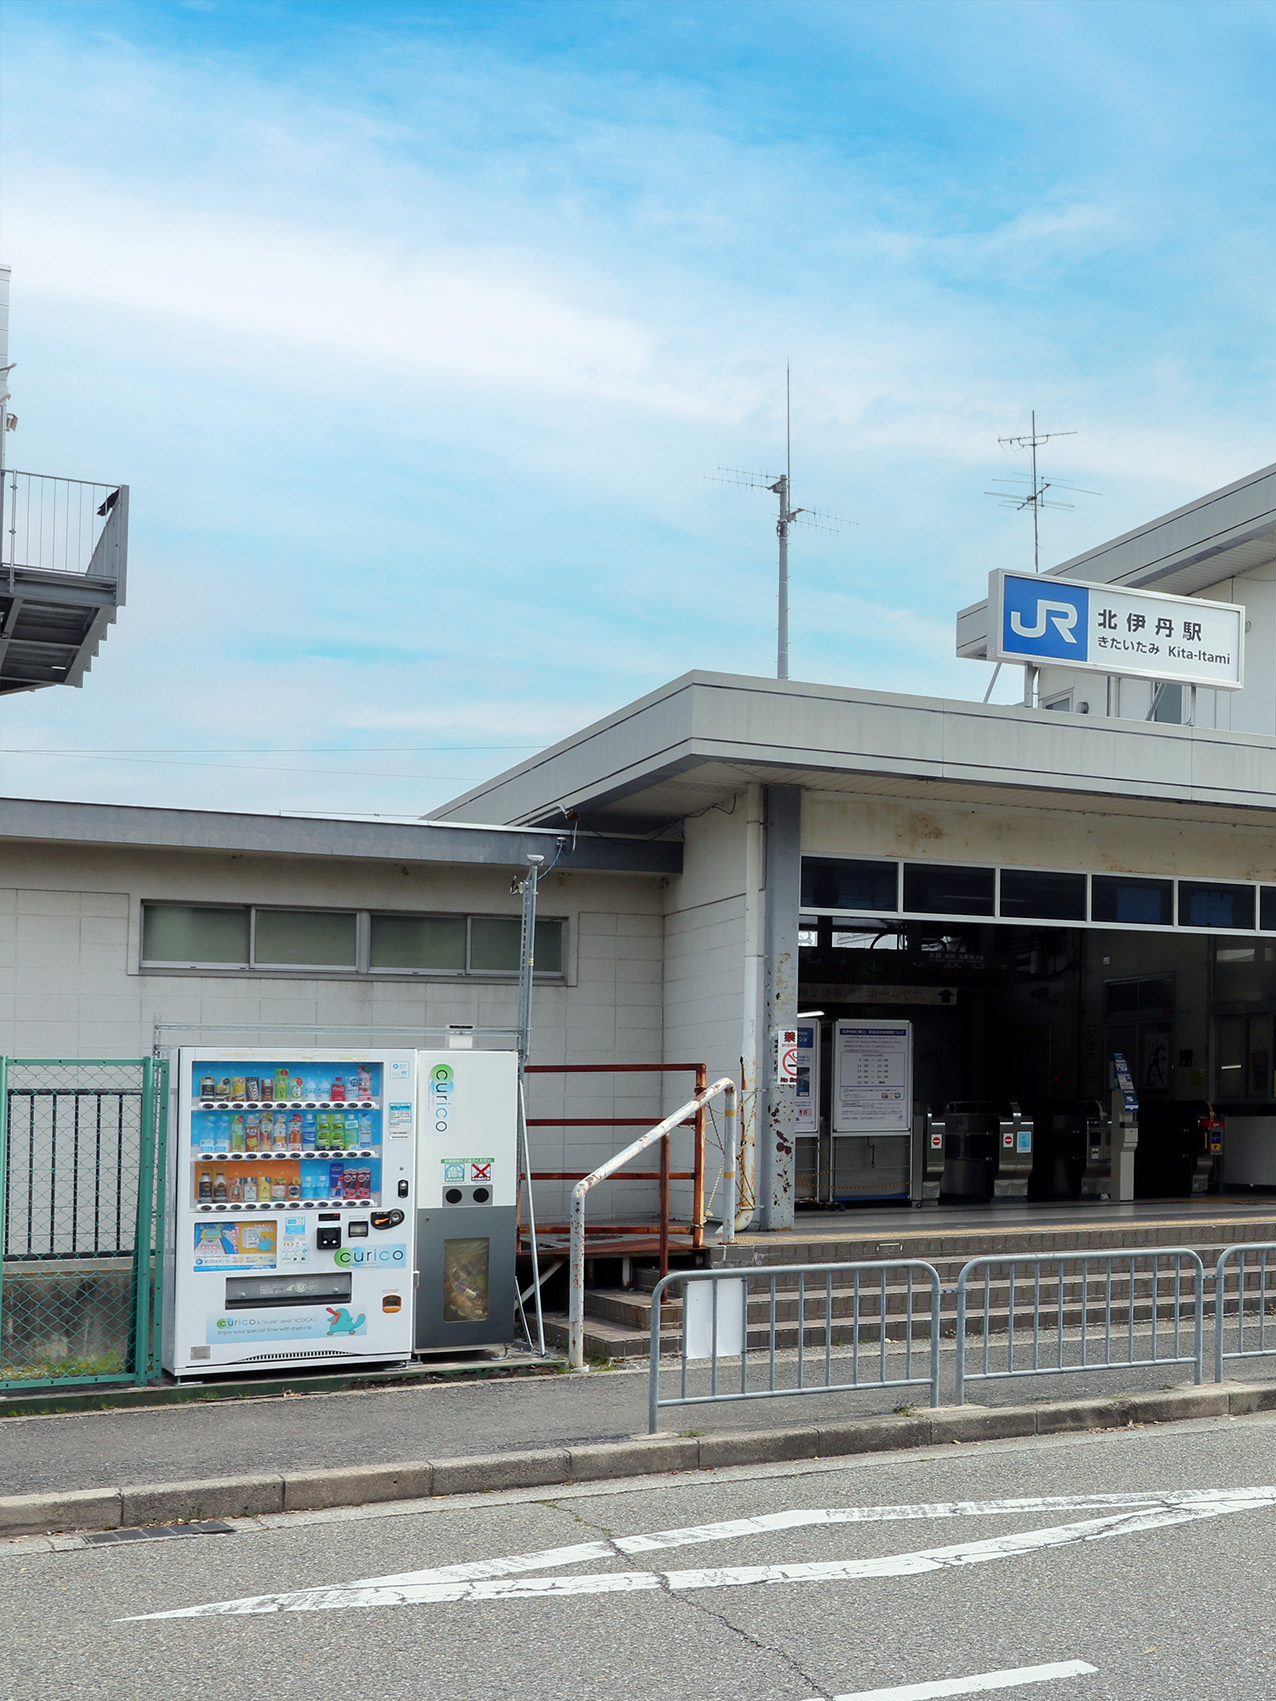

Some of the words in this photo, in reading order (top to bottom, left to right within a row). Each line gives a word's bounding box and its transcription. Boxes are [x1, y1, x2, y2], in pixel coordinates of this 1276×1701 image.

[1010, 599, 1078, 644] JR
[1097, 608, 1202, 642] 北伊丹駅
[1097, 635, 1160, 655] きたいたみ
[1168, 645, 1230, 665] Kita-Itami
[436, 1070, 451, 1132] curico
[340, 1249, 403, 1263] curico
[219, 1318, 256, 1328] curico
[246, 1327, 266, 1335] special
